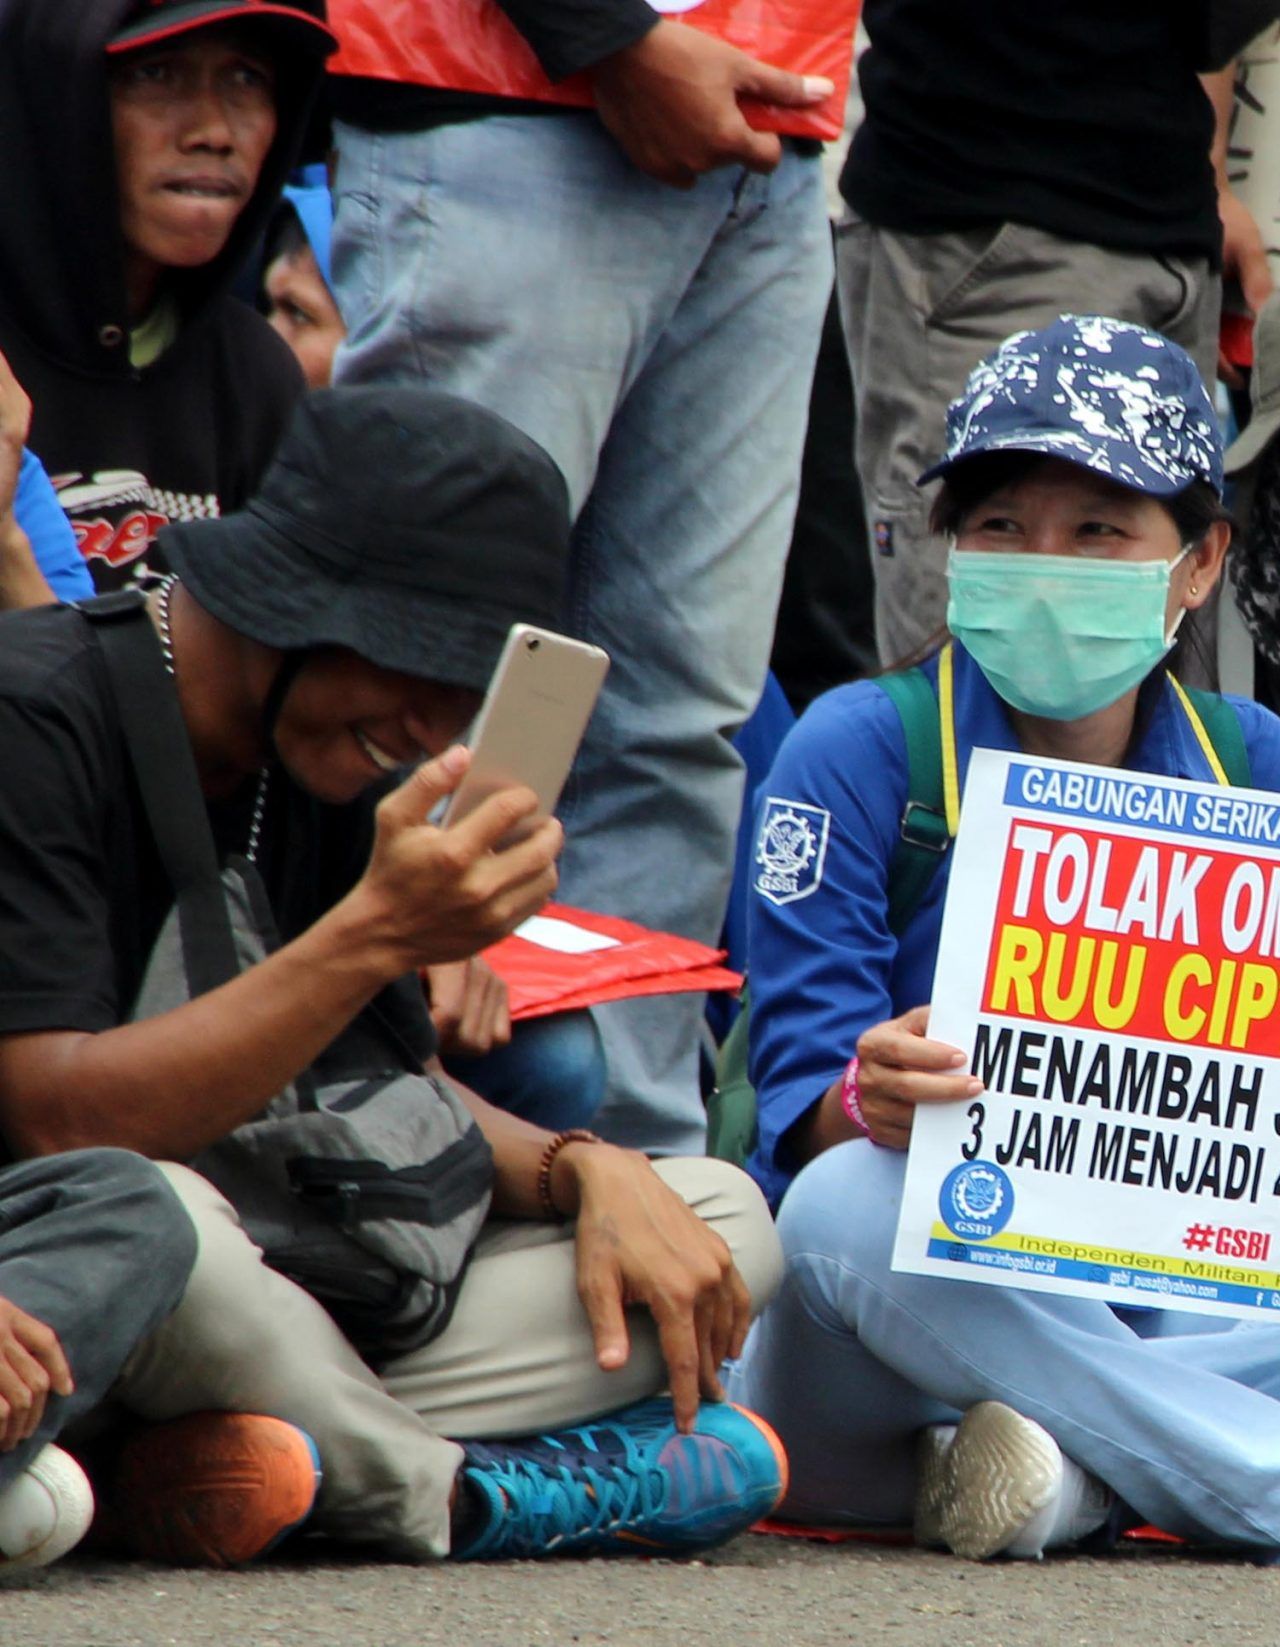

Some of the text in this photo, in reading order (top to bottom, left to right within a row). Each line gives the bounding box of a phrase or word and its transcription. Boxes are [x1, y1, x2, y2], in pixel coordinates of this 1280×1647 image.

[1022, 768, 1186, 822] GABUNGAN
[1010, 827, 1211, 946] TOLAK
[991, 924, 1151, 1029] RUU
[969, 1024, 1263, 1132] MENAMBAH
[961, 1102, 984, 1161] 3
[996, 1110, 1082, 1175] JAM
[1089, 1121, 1264, 1203] MENJADI
[954, 1221, 993, 1236] GSBI
[1018, 1235, 1173, 1274] Independen,
[1183, 1260, 1264, 1287] Militan,
[1182, 1222, 1270, 1262] #GSBI
